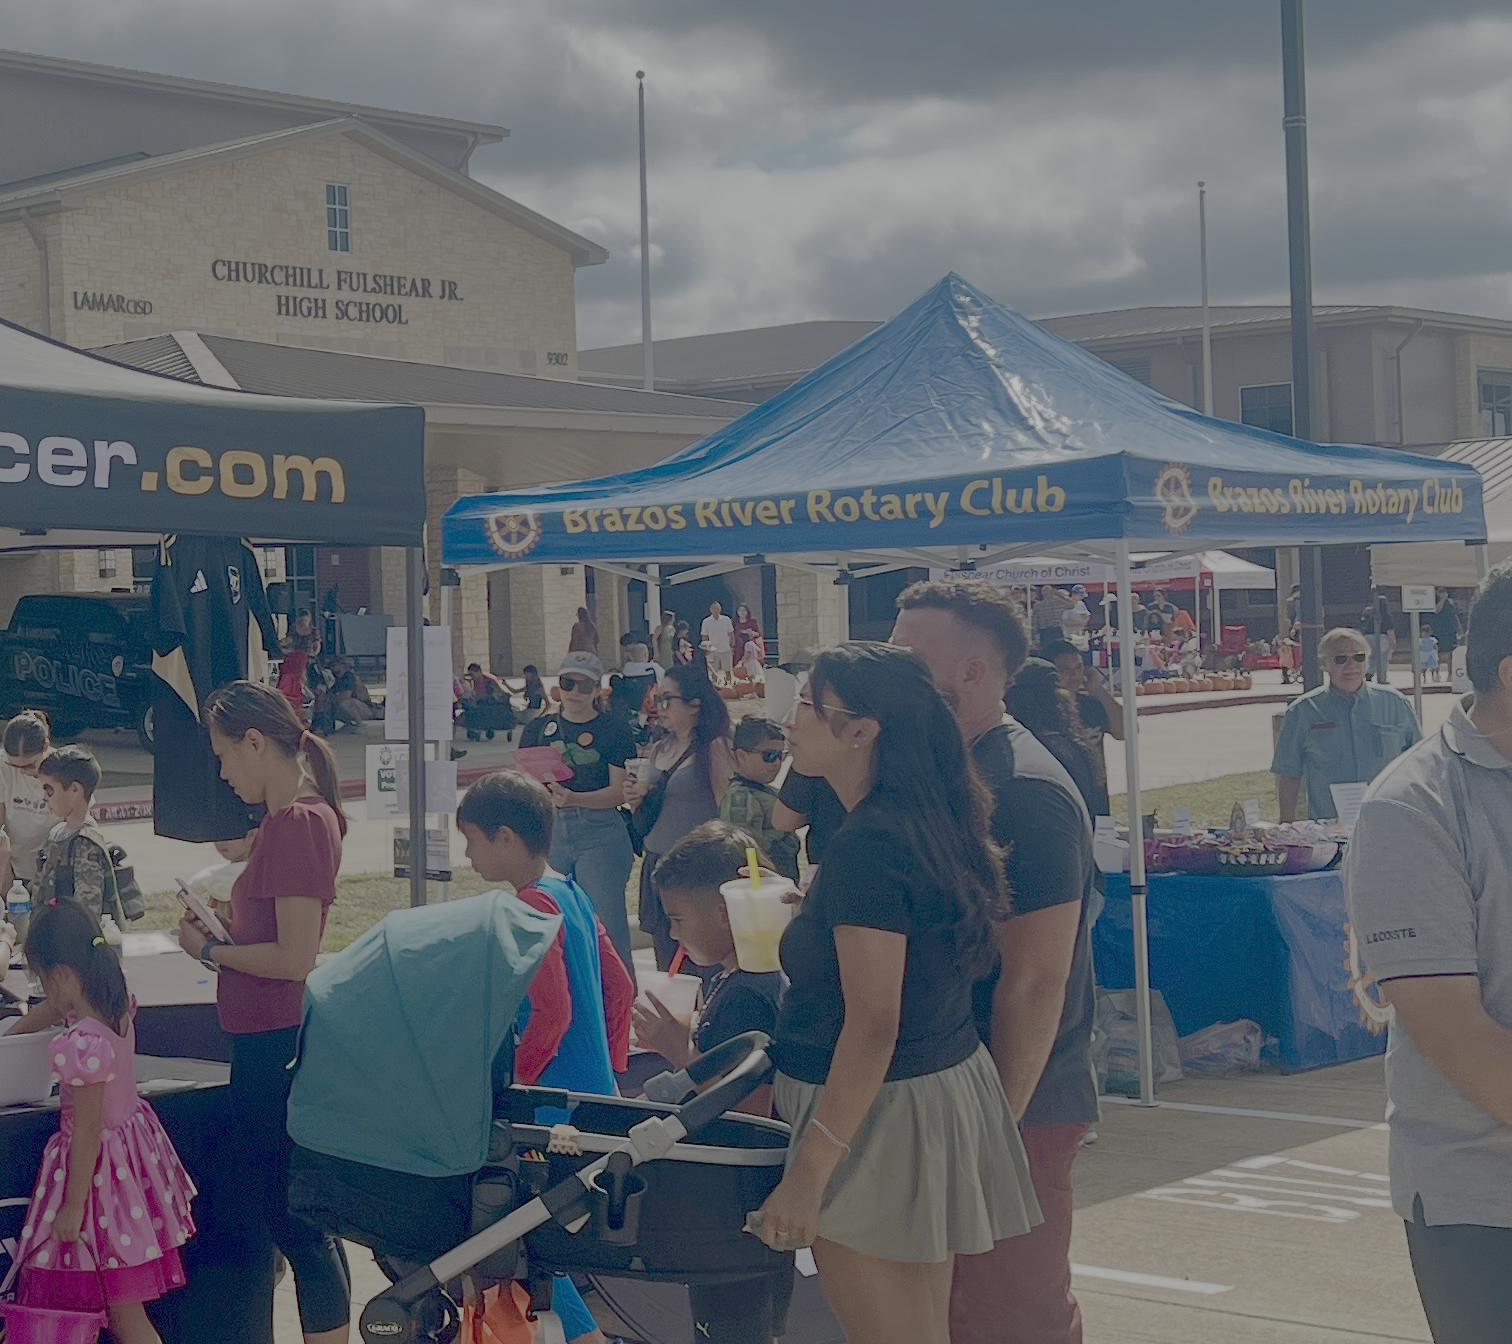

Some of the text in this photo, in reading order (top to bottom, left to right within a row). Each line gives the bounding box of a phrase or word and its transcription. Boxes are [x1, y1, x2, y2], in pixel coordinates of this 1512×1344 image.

[210, 258, 464, 302] CHURCHILL FULSHEAR JR.
[275, 294, 410, 325] HIGH SCHOOL
[547, 351, 569, 366] 9302
[562, 474, 1067, 536] Brazos River Rotary Club
[1207, 476, 1464, 525] Brazos River Rotary Club
[996, 567, 1039, 580] Church
[1041, 566, 1052, 577] of
[1054, 565, 1091, 578] Christ
[14, 651, 121, 707] POLICE
